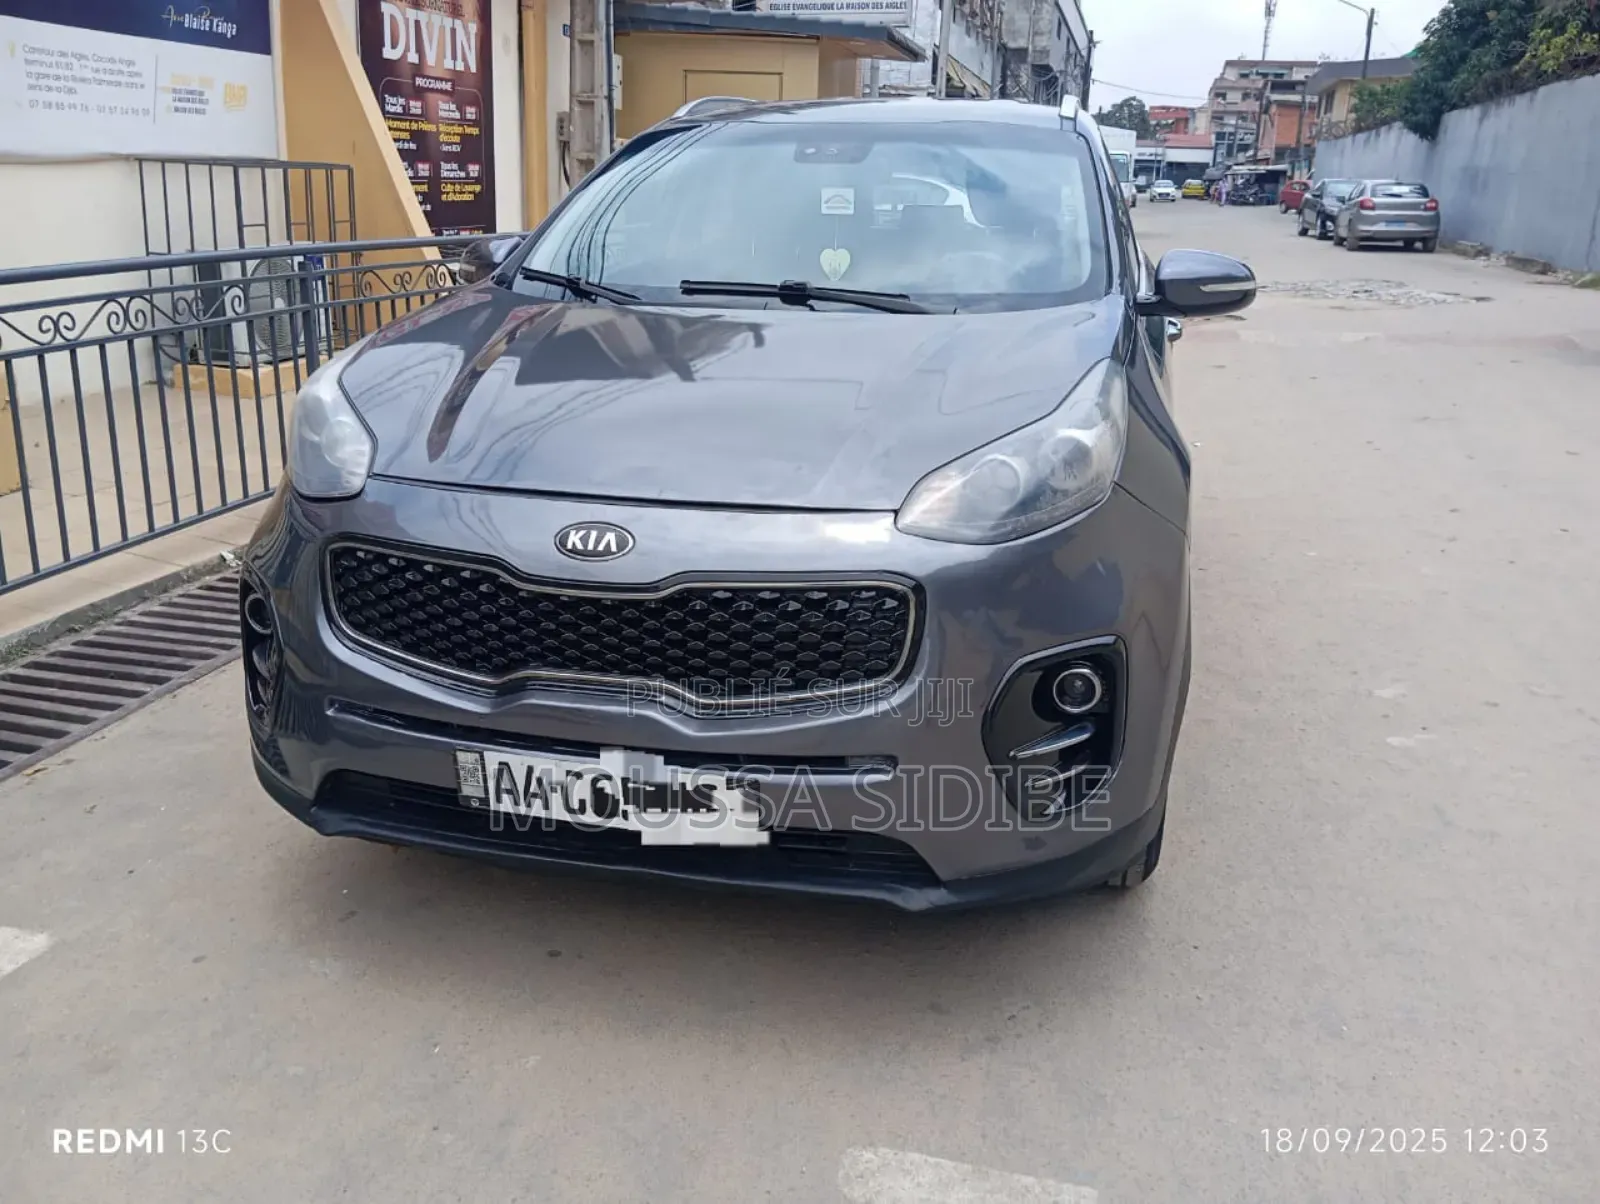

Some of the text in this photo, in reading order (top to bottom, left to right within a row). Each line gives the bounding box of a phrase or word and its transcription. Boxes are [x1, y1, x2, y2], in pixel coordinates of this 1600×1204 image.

[836, 2, 845, 10] LA
[846, 2, 871, 10] MAISON
[184, 13, 210, 31] Blaise
[212, 17, 237, 39] Kanga
[380, 1, 477, 73] DIVIN
[415, 77, 453, 91] PROGRAMME
[567, 529, 617, 552] KIA
